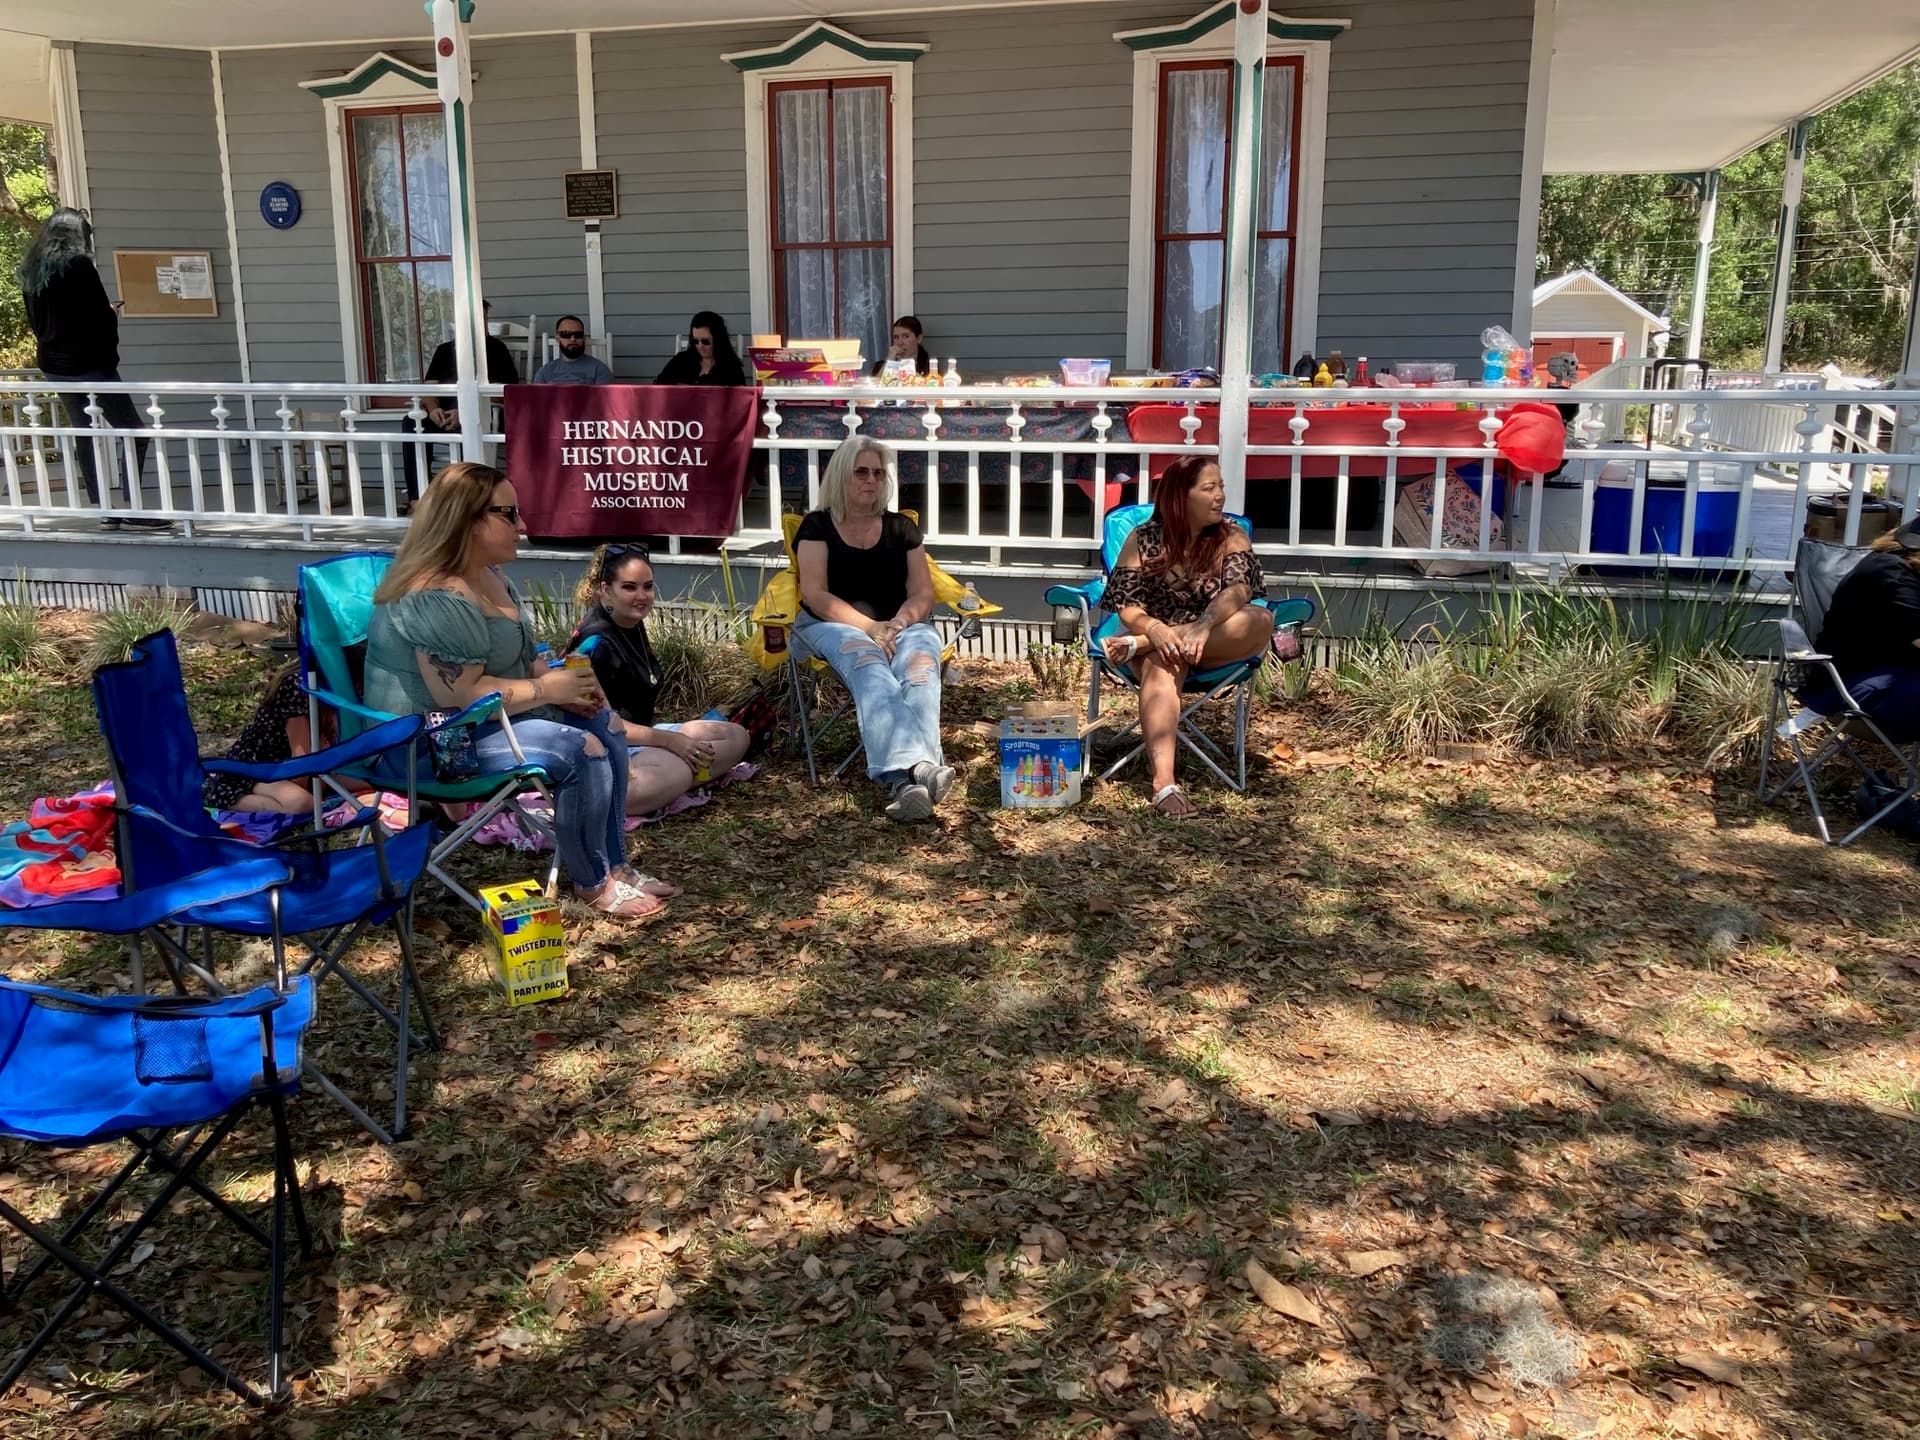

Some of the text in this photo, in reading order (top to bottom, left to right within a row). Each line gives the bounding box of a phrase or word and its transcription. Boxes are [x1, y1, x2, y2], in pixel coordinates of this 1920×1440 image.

[562, 420, 704, 440] HERNANDO
[561, 446, 708, 466] HISTORICAL
[584, 472, 689, 492] MUSEUM
[591, 496, 686, 509] ASSOCIATION
[508, 938, 562, 957] TWISTED TEA
[514, 978, 566, 997] PARTY PACK
